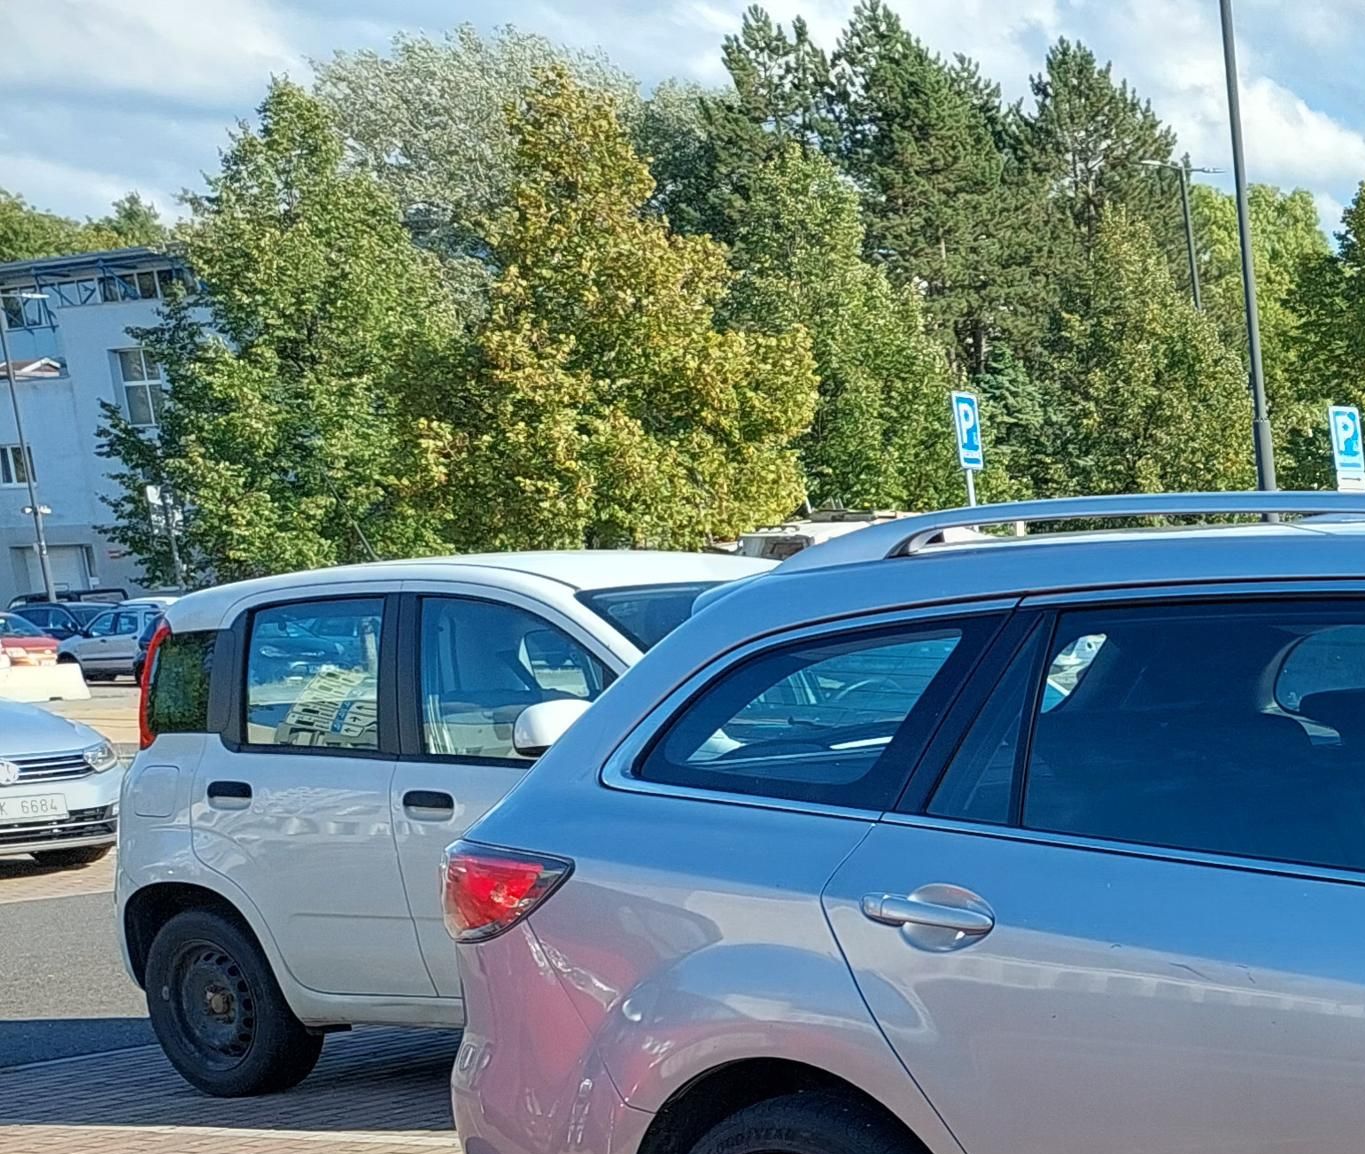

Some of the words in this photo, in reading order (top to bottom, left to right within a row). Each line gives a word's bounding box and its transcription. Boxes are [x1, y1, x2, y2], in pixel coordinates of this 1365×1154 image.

[959, 402, 975, 444] P
[1336, 415, 1355, 452] P
[20, 798, 58, 814] 6684
